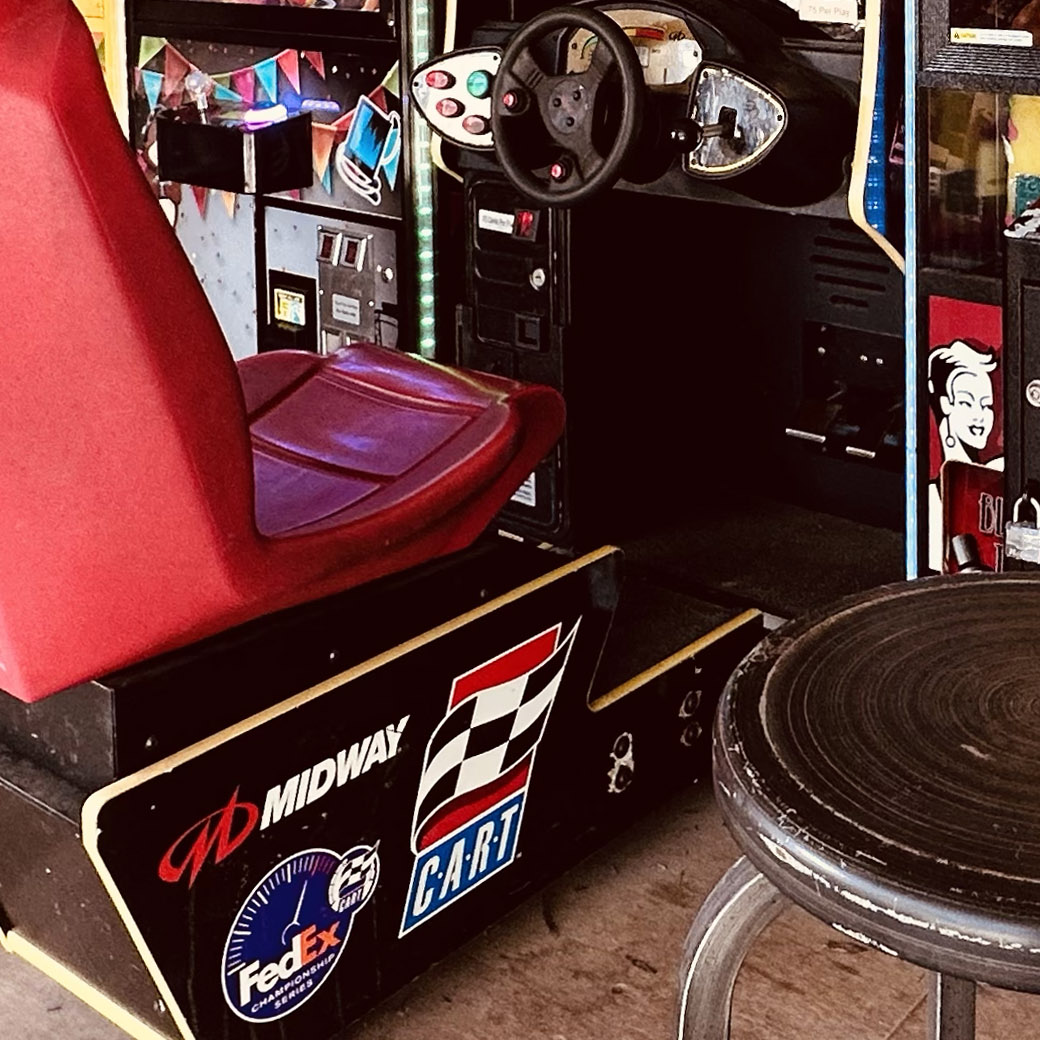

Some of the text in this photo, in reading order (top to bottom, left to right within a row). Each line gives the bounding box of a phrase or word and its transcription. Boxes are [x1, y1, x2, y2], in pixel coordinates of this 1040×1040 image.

[260, 715, 411, 831] MIDWAY
[239, 921, 342, 1007] FedEx
[250, 952, 336, 1013] CHAMPIONSHIP
[273, 978, 314, 1010] SERIES
